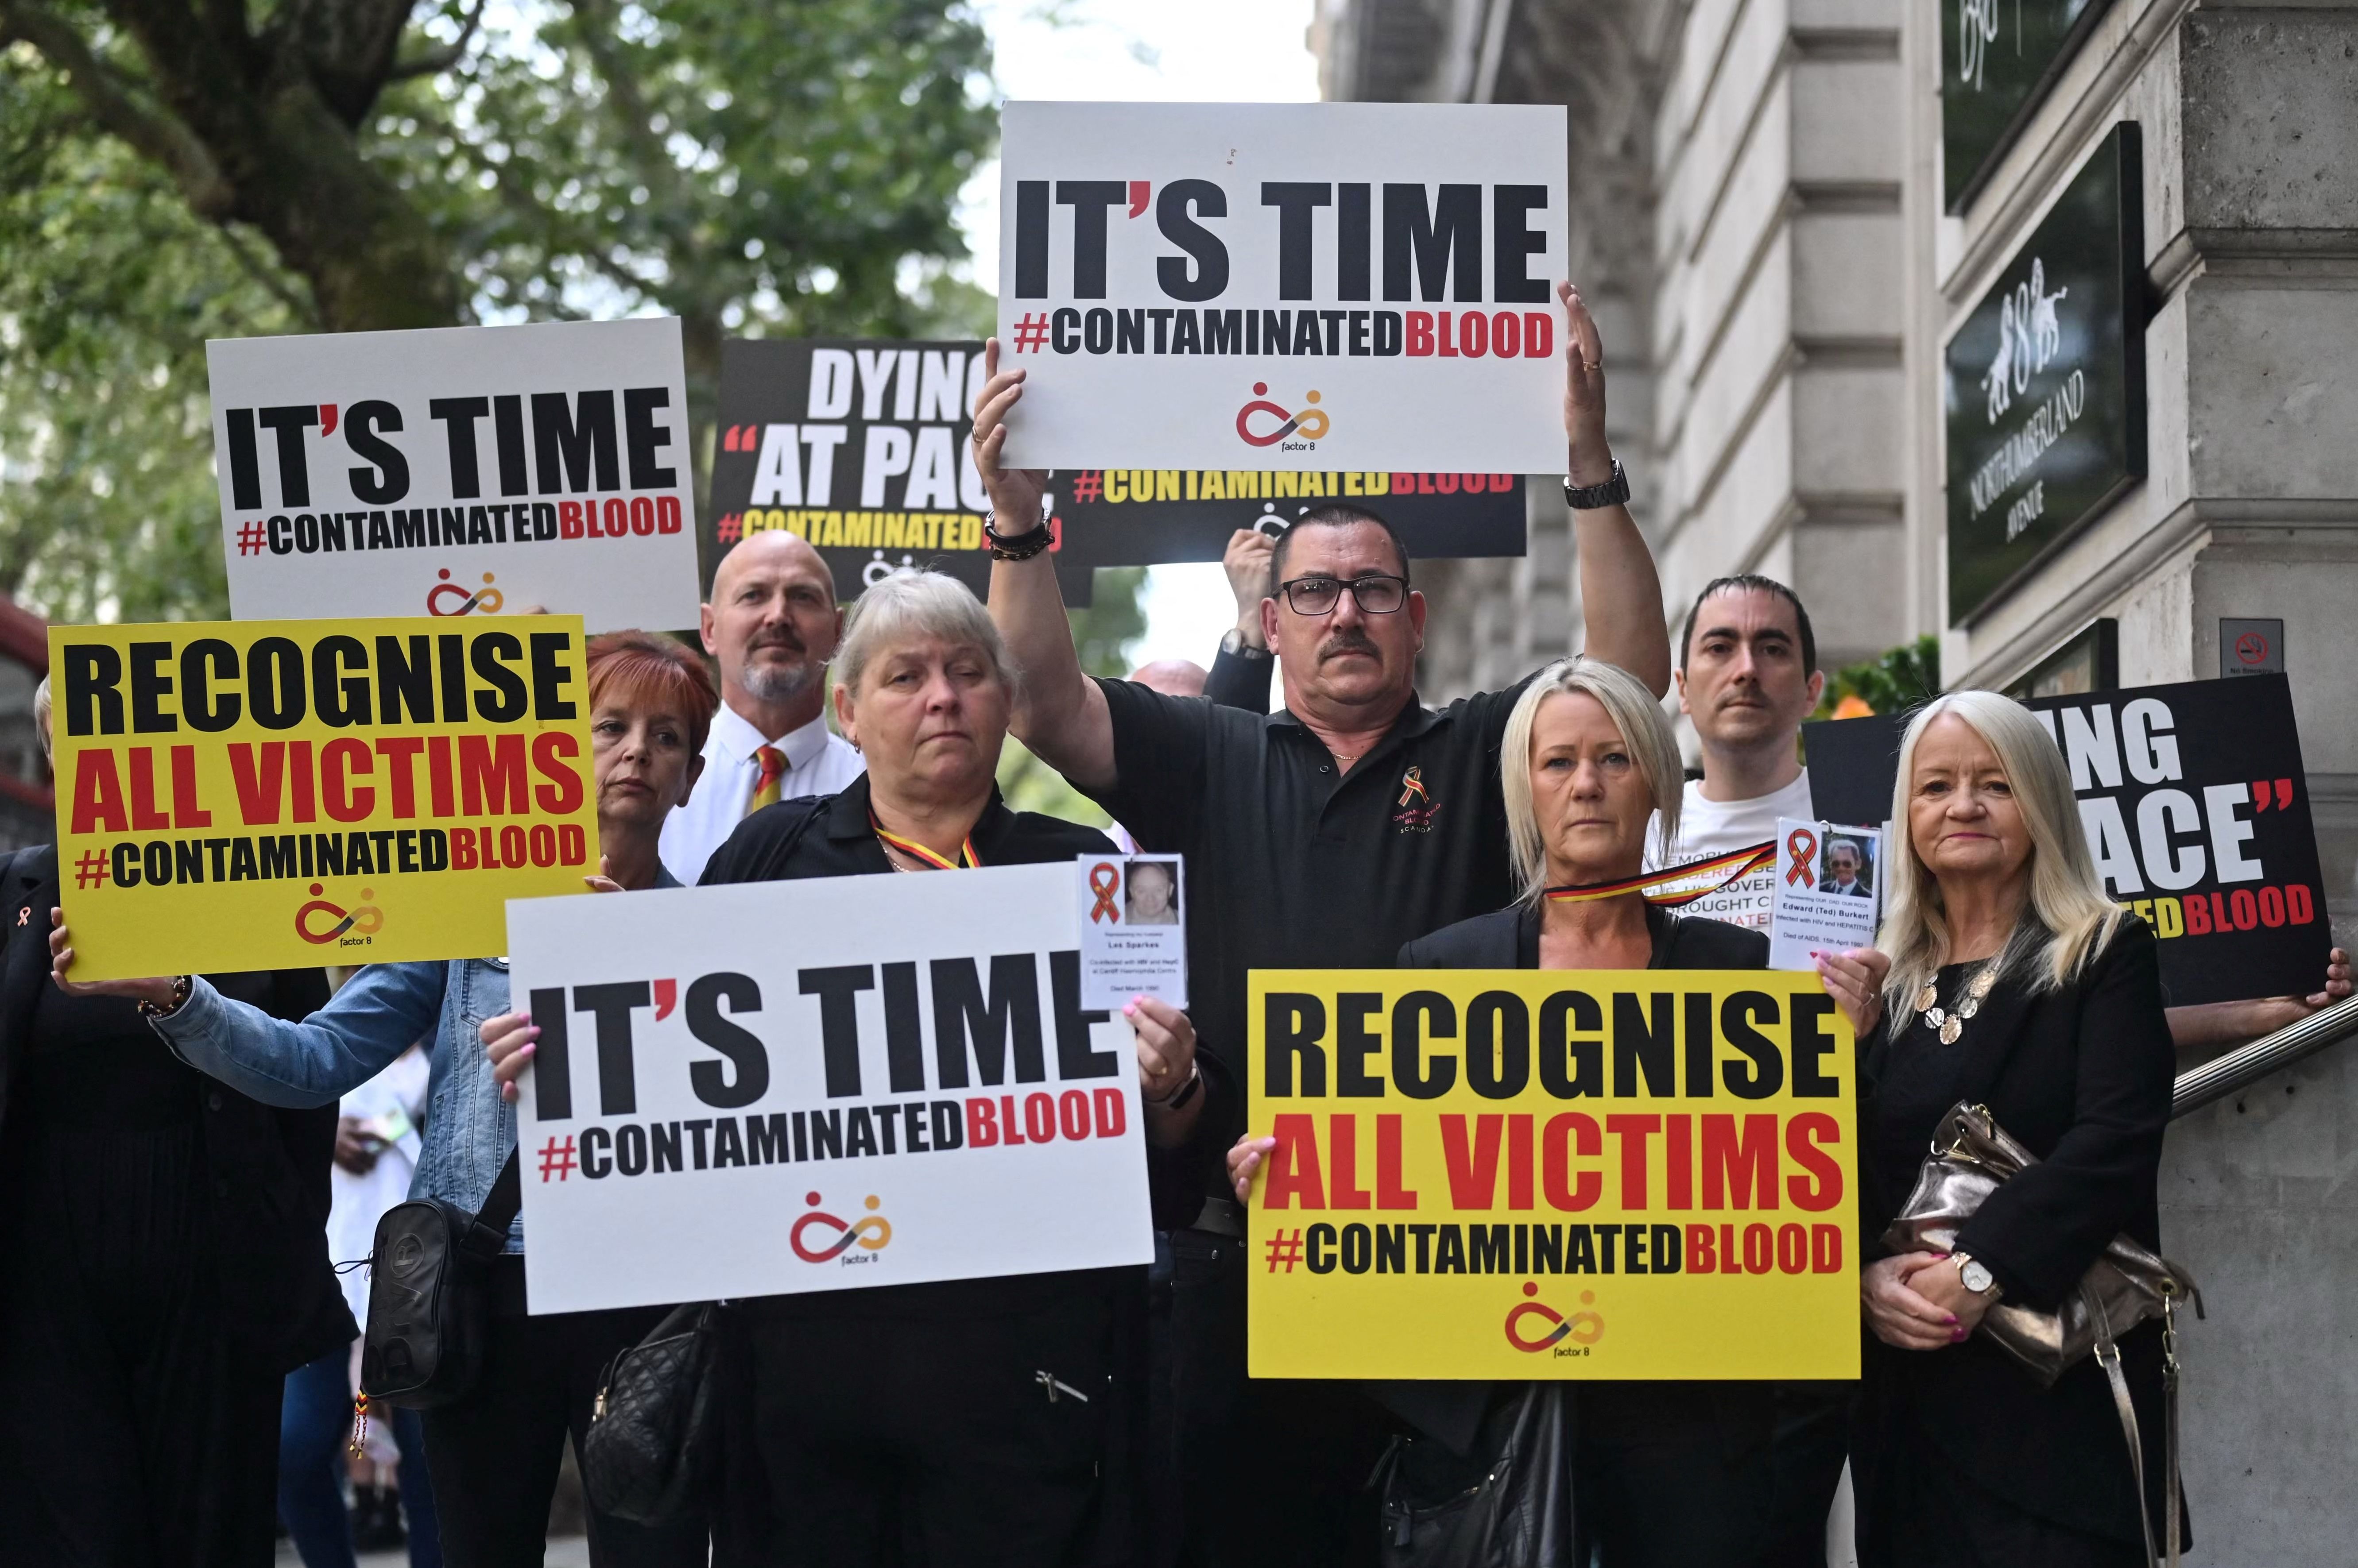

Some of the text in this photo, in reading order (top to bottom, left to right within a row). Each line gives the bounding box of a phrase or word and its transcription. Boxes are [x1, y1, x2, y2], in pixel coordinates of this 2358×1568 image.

[1014, 179, 1550, 303] IT'S TIME
[1014, 307, 1553, 358] #CONTAMINATEDBLOOD
[807, 349, 987, 421] DYIN
[226, 387, 677, 510] IT'S TIME
[1282, 442, 1307, 452] factor
[237, 496, 681, 556] #CONTAMINATEDBLOOD
[63, 632, 577, 736] RECOGNISE
[71, 731, 584, 834] ALL VICTIMS
[75, 823, 586, 889] #CONTAMINATEDBLOOD
[2078, 779, 2293, 894] ACE"
[340, 937, 364, 948] factor
[1783, 903, 1869, 919] Edward (Ted) Burkert
[1837, 922, 1868, 931] HEPATITIS
[530, 950, 1119, 1121] IT'S TIME
[1264, 990, 1840, 1100] RECOGNISE
[538, 1087, 1126, 1183] #CONTAMINATEDBLOOD
[1263, 1112, 1843, 1212] ALL VICTIMS
[842, 1252, 878, 1267] factor 8
[1265, 1222, 1843, 1274] #CONTAMINATEDBLOOD
[1554, 1347, 1590, 1359] factor 8
